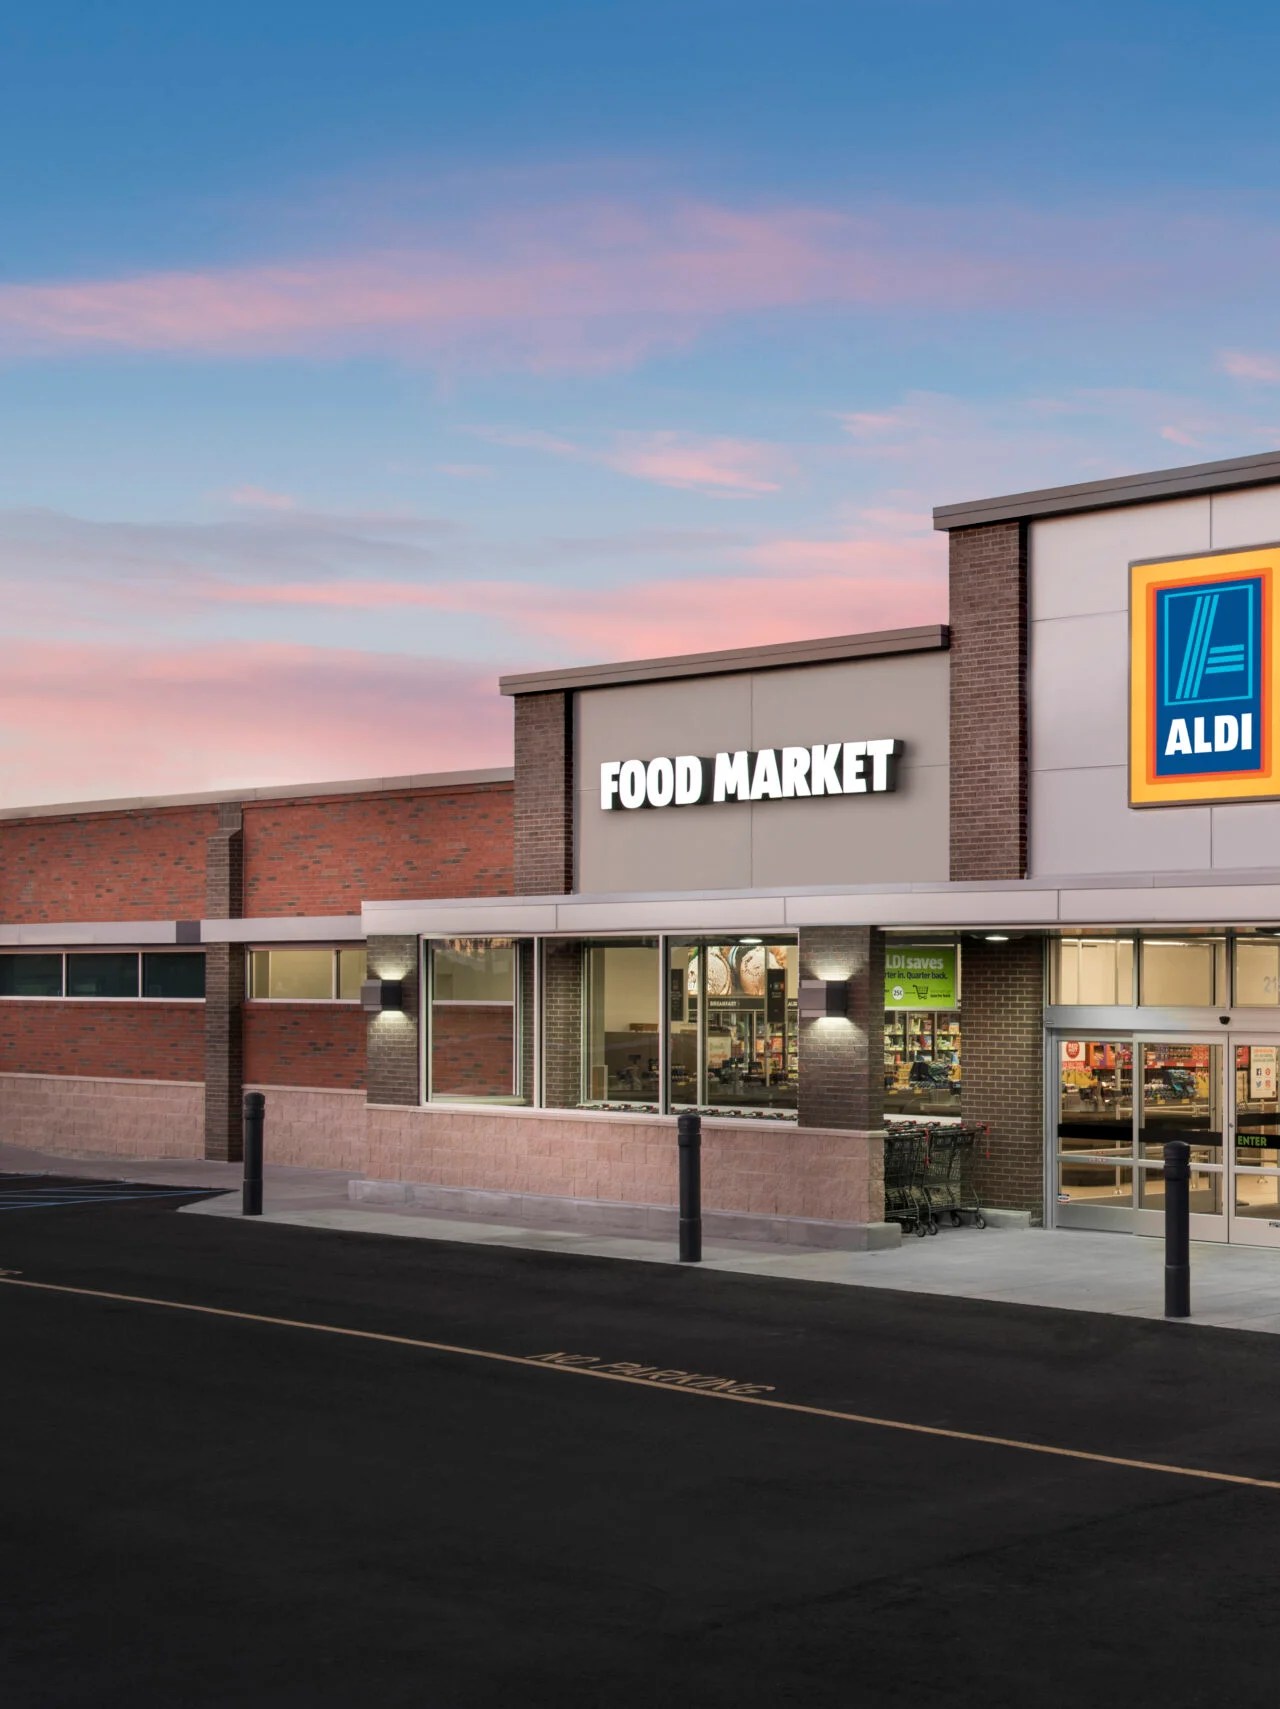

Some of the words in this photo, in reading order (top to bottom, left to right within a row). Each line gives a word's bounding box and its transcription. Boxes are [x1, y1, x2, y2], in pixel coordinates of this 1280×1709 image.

[1164, 712, 1253, 756] ALDI
[600, 754, 703, 810] FOOD
[712, 738, 896, 803] MARKET
[885, 955, 905, 969] LDI
[906, 957, 944, 970] saves
[907, 972, 931, 980] Quarter
[1237, 1135, 1267, 1147] ENTER
[525, 1351, 601, 1366] NO
[589, 1361, 776, 1395] PARKING
